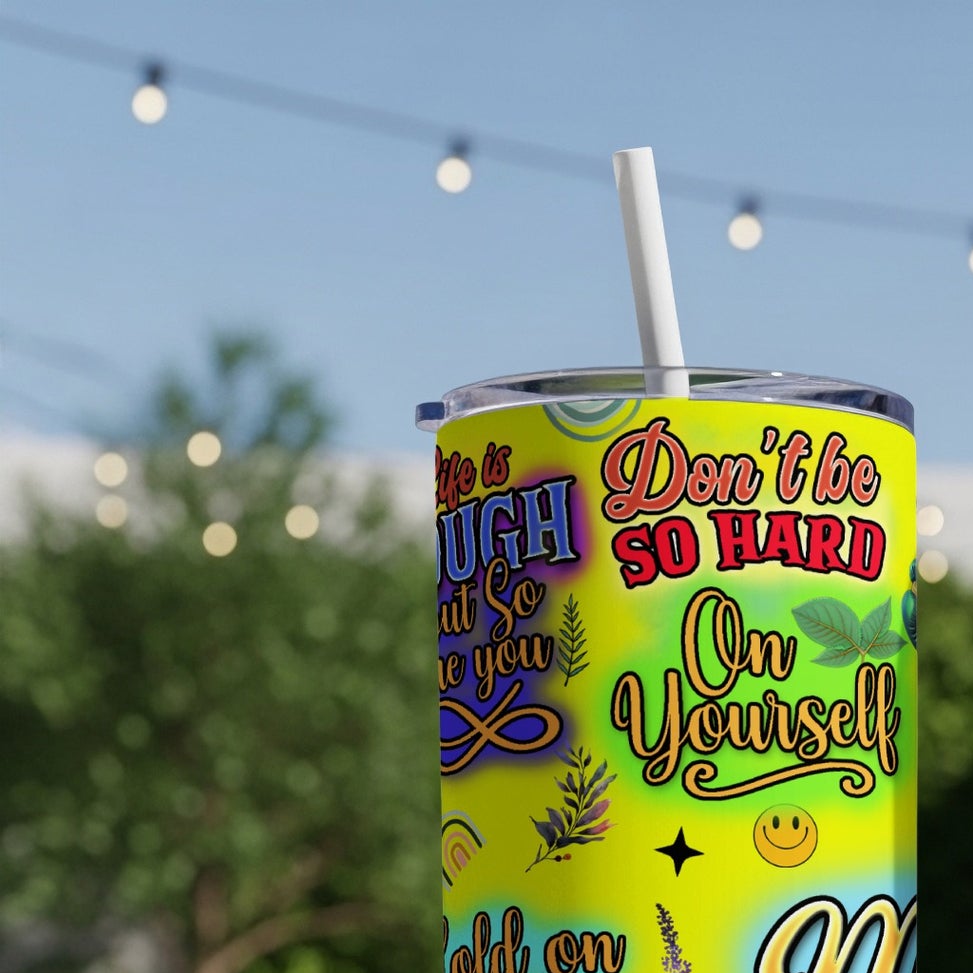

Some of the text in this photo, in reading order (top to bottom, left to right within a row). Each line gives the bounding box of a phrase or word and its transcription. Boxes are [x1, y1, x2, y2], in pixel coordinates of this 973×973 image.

[482, 442, 512, 487] is
[601, 417, 881, 521] Don't be
[437, 475, 581, 587] UGH
[612, 508, 886, 588] SO HARD
[438, 557, 546, 642] ut So
[681, 586, 796, 698] On
[474, 635, 554, 701] you
[610, 662, 901, 786] Yourself
